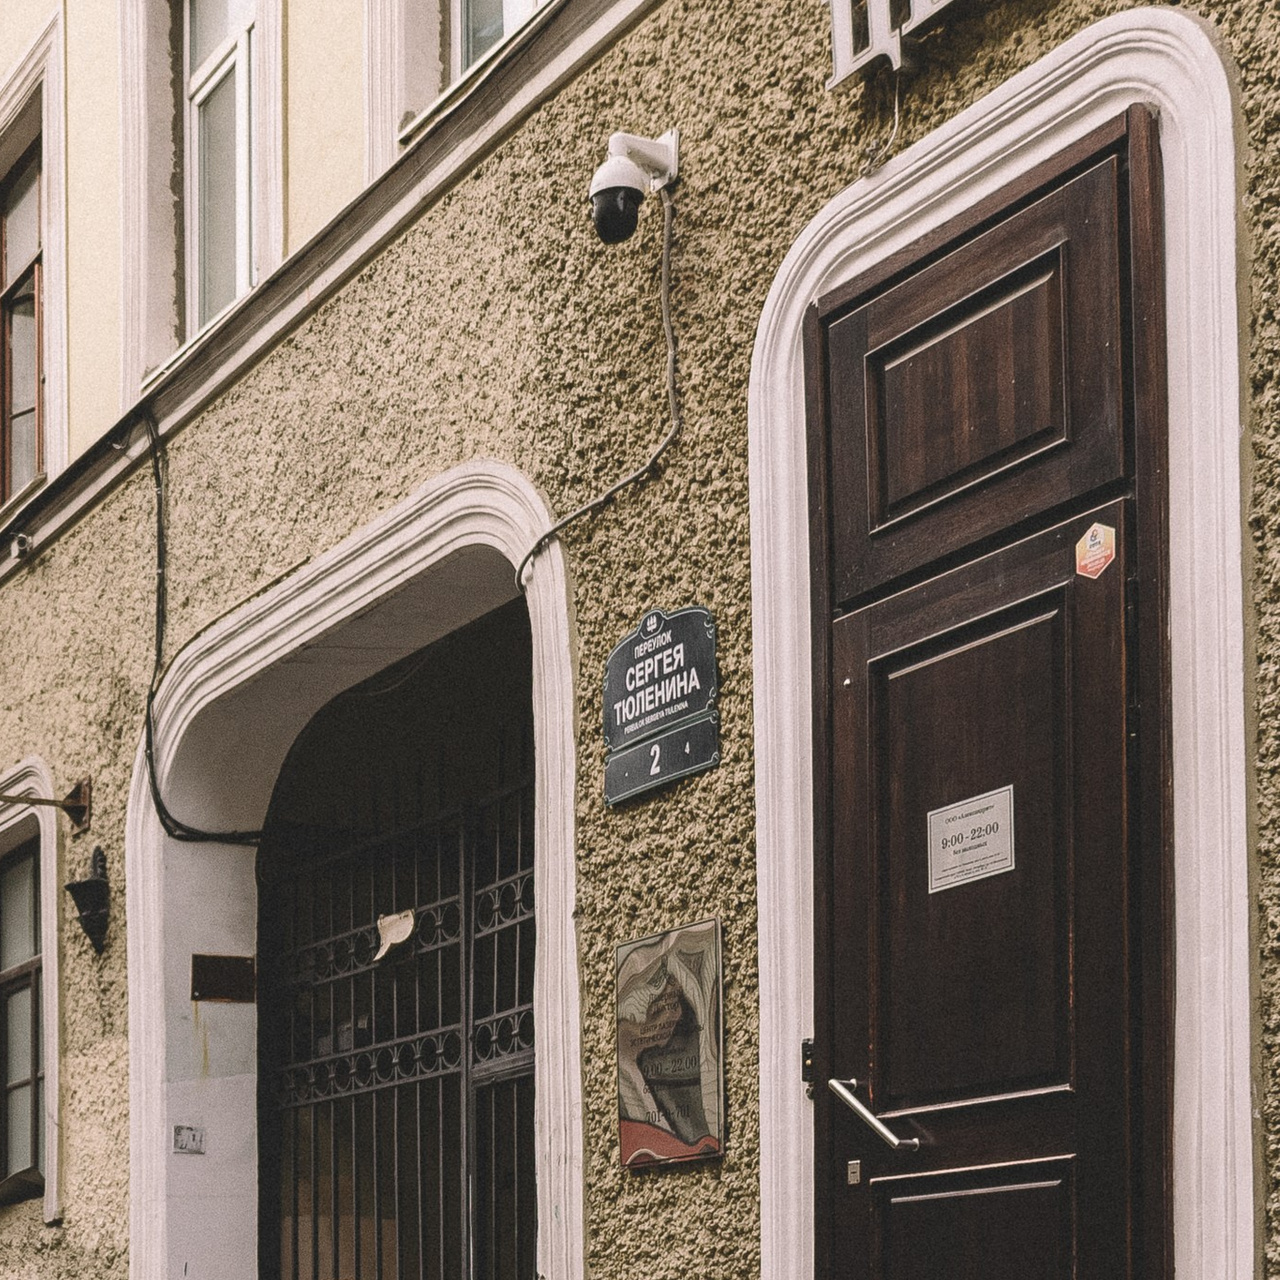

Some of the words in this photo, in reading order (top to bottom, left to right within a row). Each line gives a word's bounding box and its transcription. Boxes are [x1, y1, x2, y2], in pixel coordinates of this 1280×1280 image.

[634, 629, 672, 659] ПЕРЕУЛОК
[625, 642, 684, 692] СЕРГЕЯ
[613, 667, 701, 726] ТЮЛЕНИНА
[649, 743, 661, 776] 2
[684, 741, 690, 754] 4
